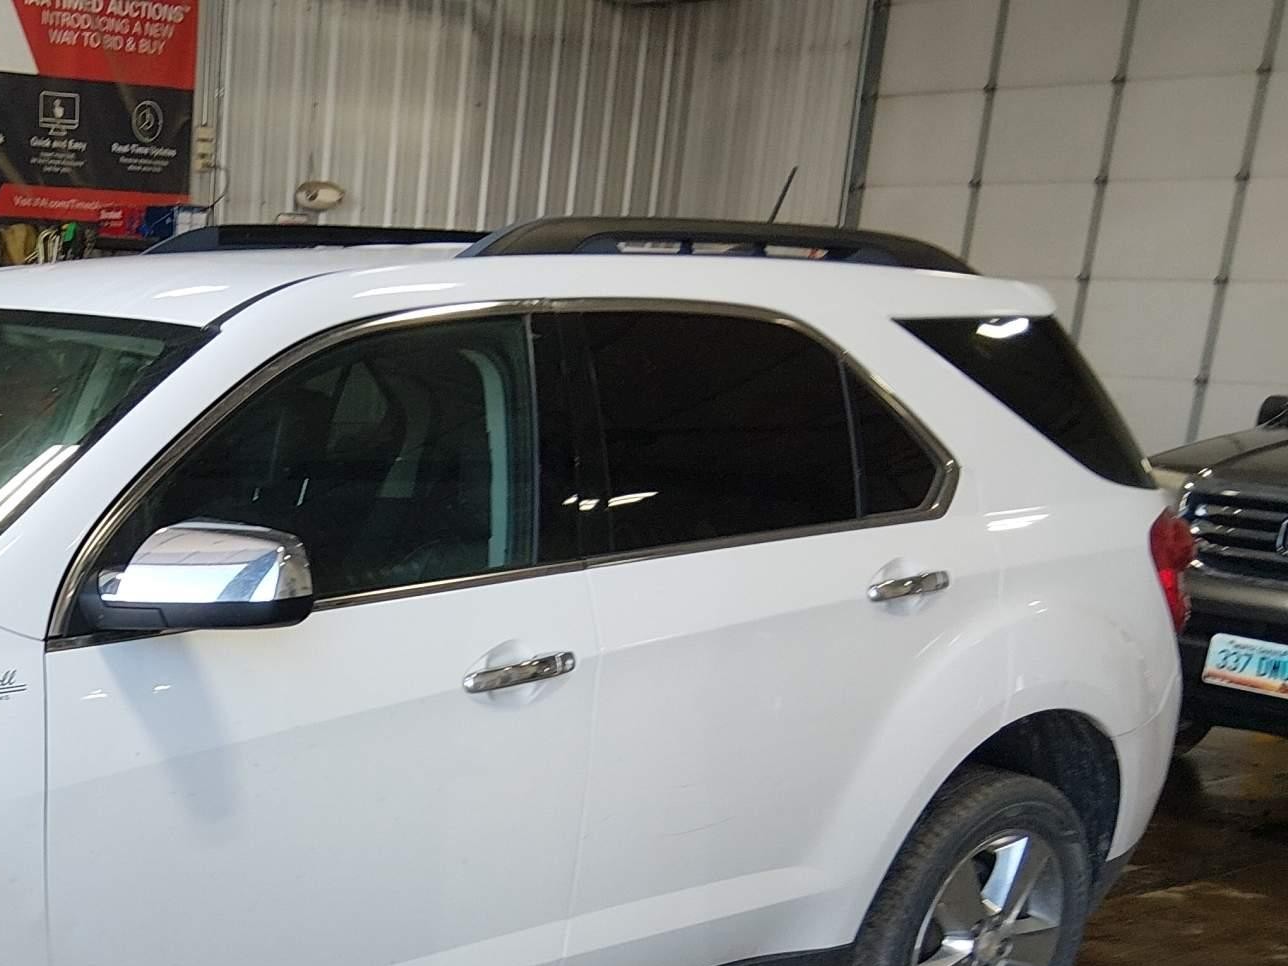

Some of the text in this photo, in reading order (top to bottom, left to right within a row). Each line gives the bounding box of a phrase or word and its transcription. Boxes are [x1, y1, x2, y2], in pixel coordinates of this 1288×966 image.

[40, 10, 175, 40] INTRODUCING A NEW
[48, 29, 166, 55] WAY TO BID & BUY
